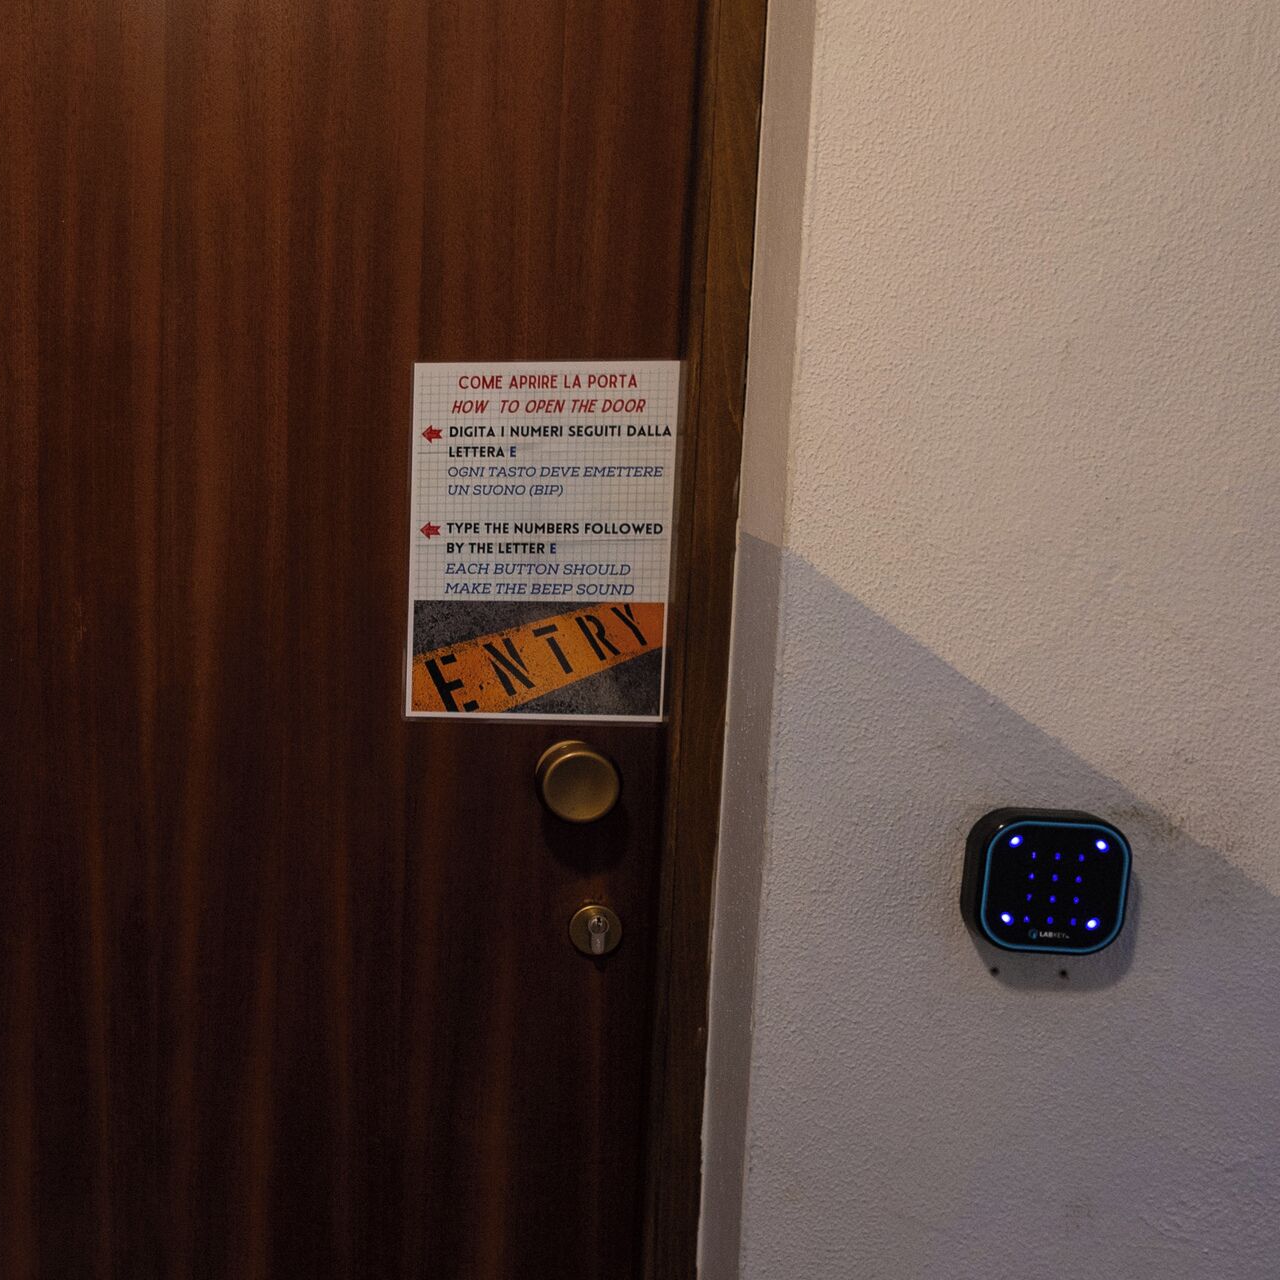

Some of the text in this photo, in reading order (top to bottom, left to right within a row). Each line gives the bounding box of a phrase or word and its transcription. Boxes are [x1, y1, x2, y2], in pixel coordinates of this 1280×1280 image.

[458, 374, 638, 389] COME APRIRE LA PORTA
[451, 399, 646, 414] HOW TO OPEN THE DOOR
[449, 425, 672, 438] DIGITA I NUMERI SEGUITI DALLA
[449, 447, 517, 458] LETTERA E
[448, 466, 663, 478] OGNI TASTO DEVE EMETTERE
[448, 484, 563, 497] UN SUONO (BIP)
[447, 523, 663, 534] TYPE THE NUMBERS FOLLOWED
[447, 543, 557, 554] BY THE LETTER E
[445, 563, 631, 576] EACH BUTTON SHOULD
[445, 583, 634, 595] MAKE THE BEEP SOUND
[425, 603, 647, 712] ENTRY
